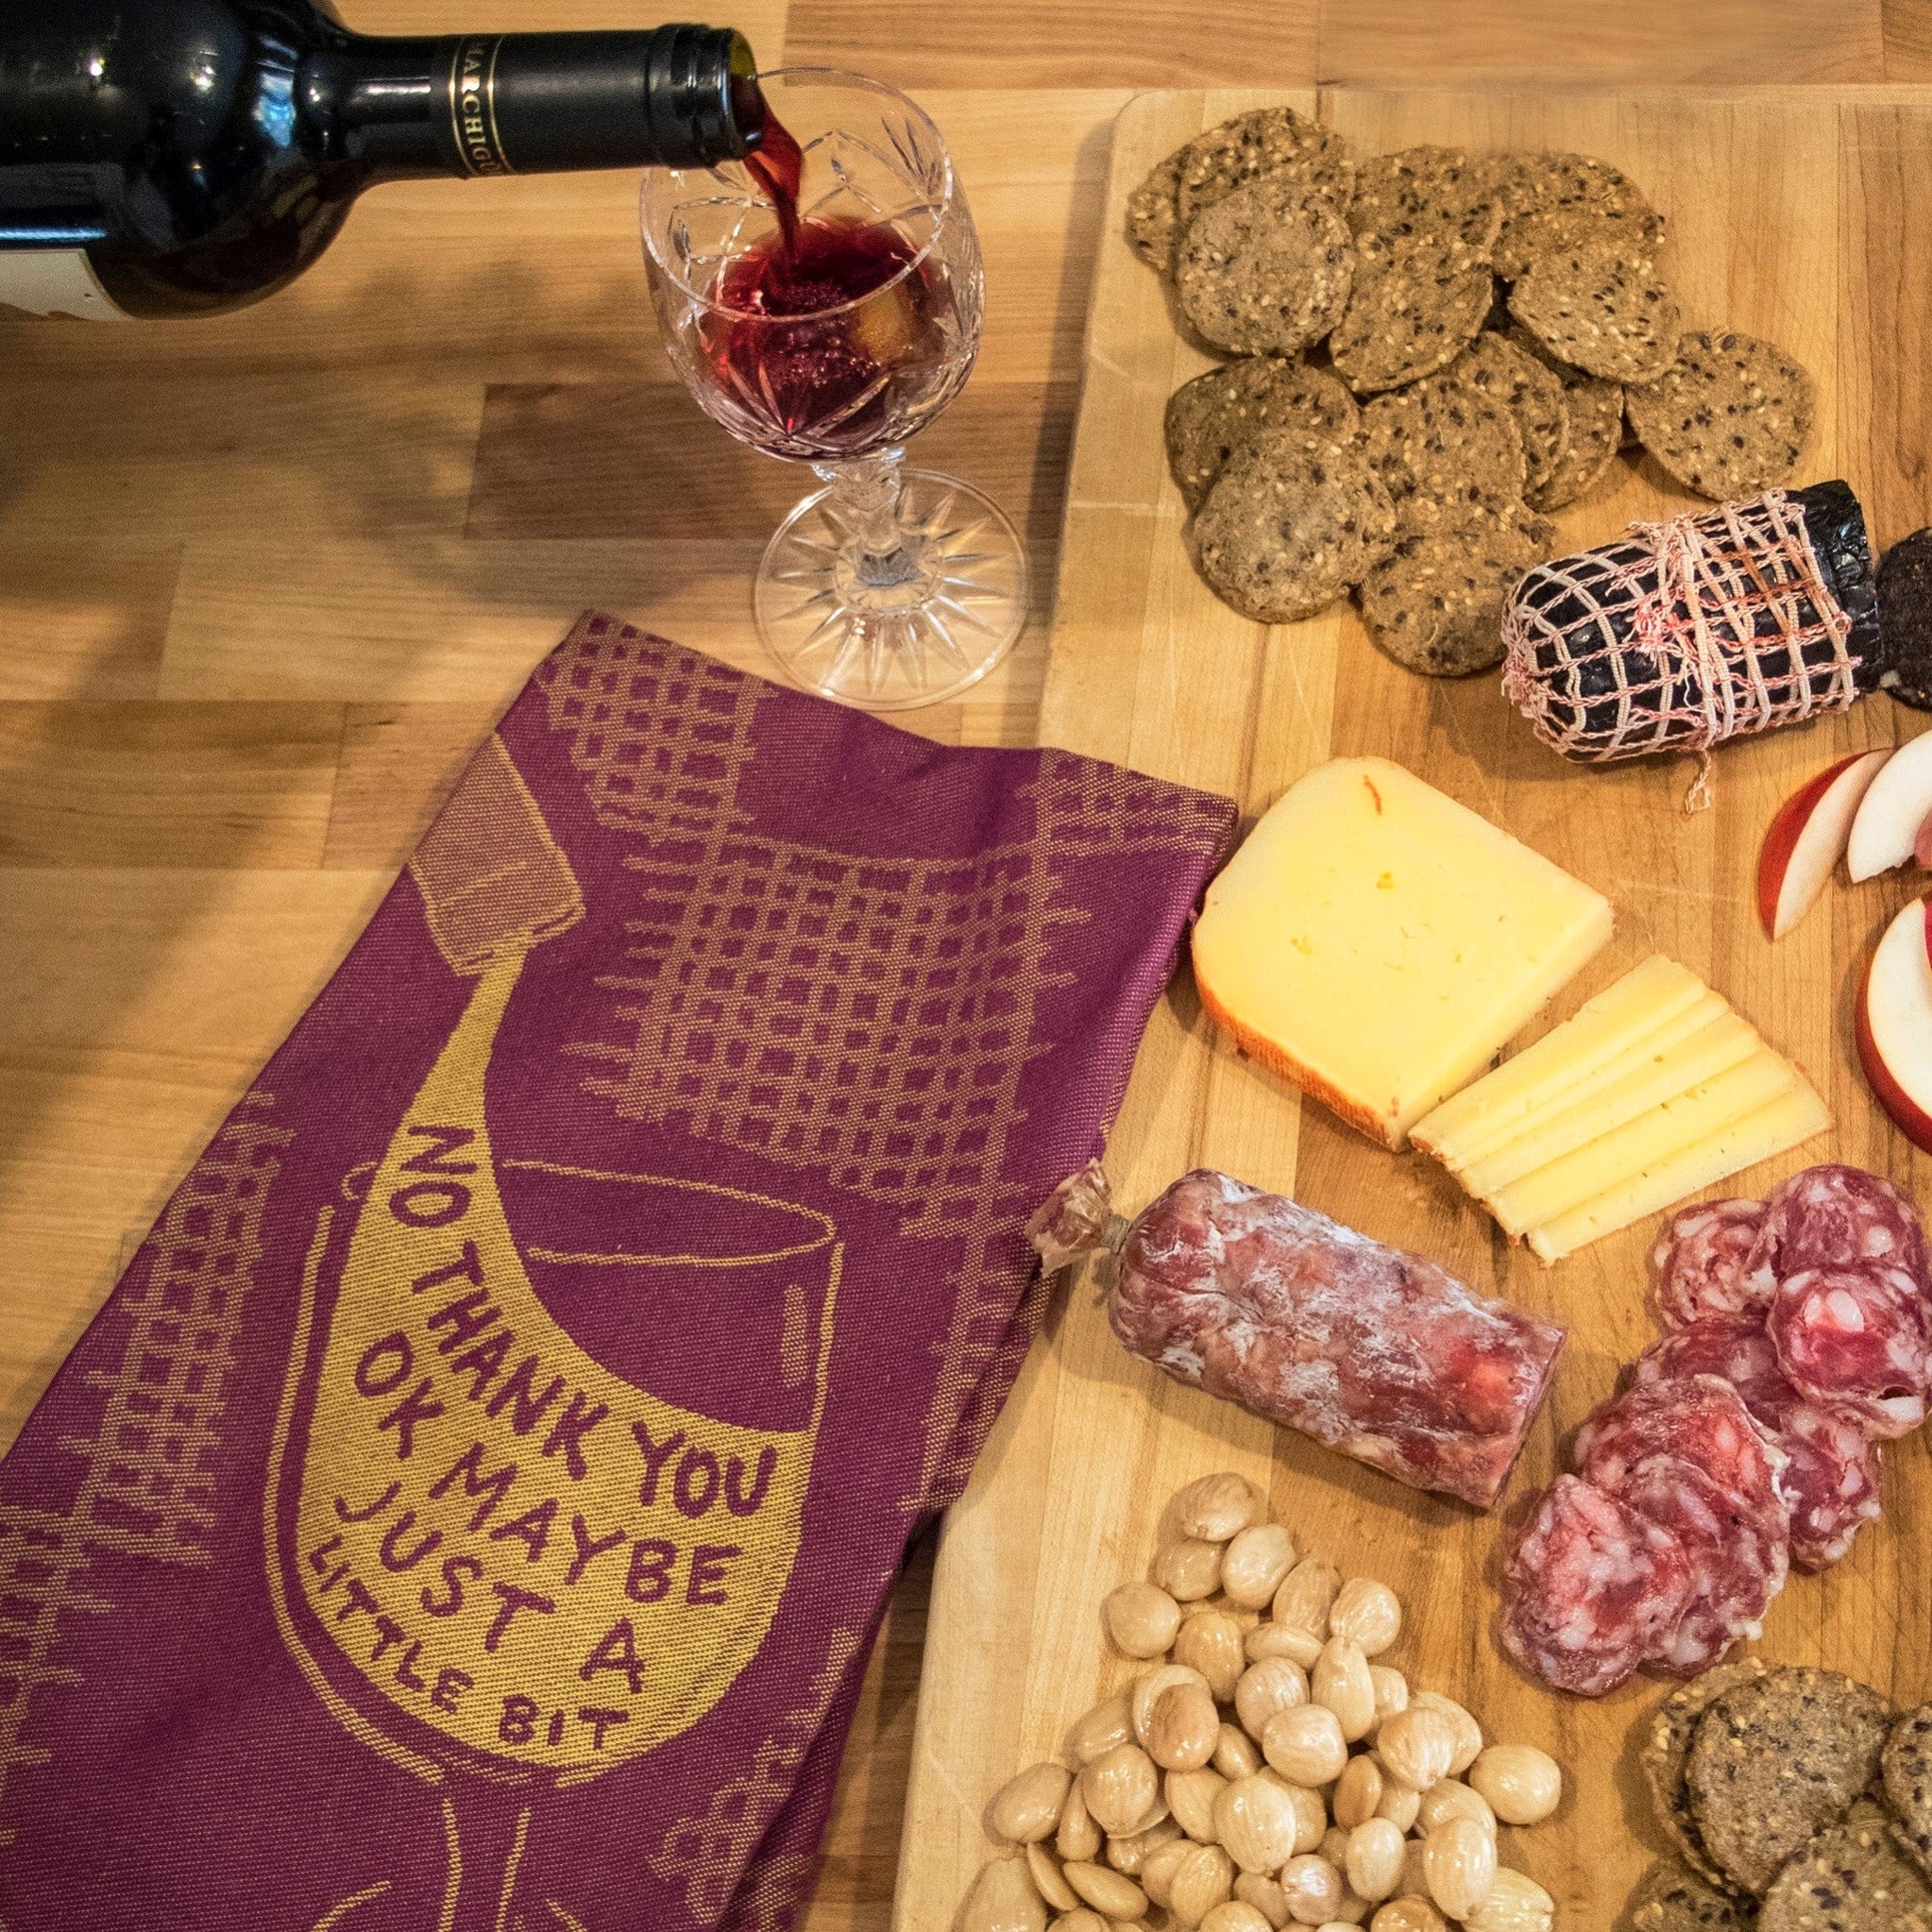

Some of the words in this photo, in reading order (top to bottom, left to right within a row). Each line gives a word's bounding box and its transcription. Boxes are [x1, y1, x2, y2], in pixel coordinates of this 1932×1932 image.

[388, 1125, 478, 1228] NO
[412, 1242, 610, 1480] THANK
[354, 1332, 446, 1459] OK
[429, 1443, 742, 1606] MAYBE
[633, 1421, 777, 1517] YOU
[311, 1538, 473, 1713] LITTLE
[498, 1696, 630, 1750] BIT
[336, 1483, 555, 1652] JUST
[579, 1619, 646, 1693] A
